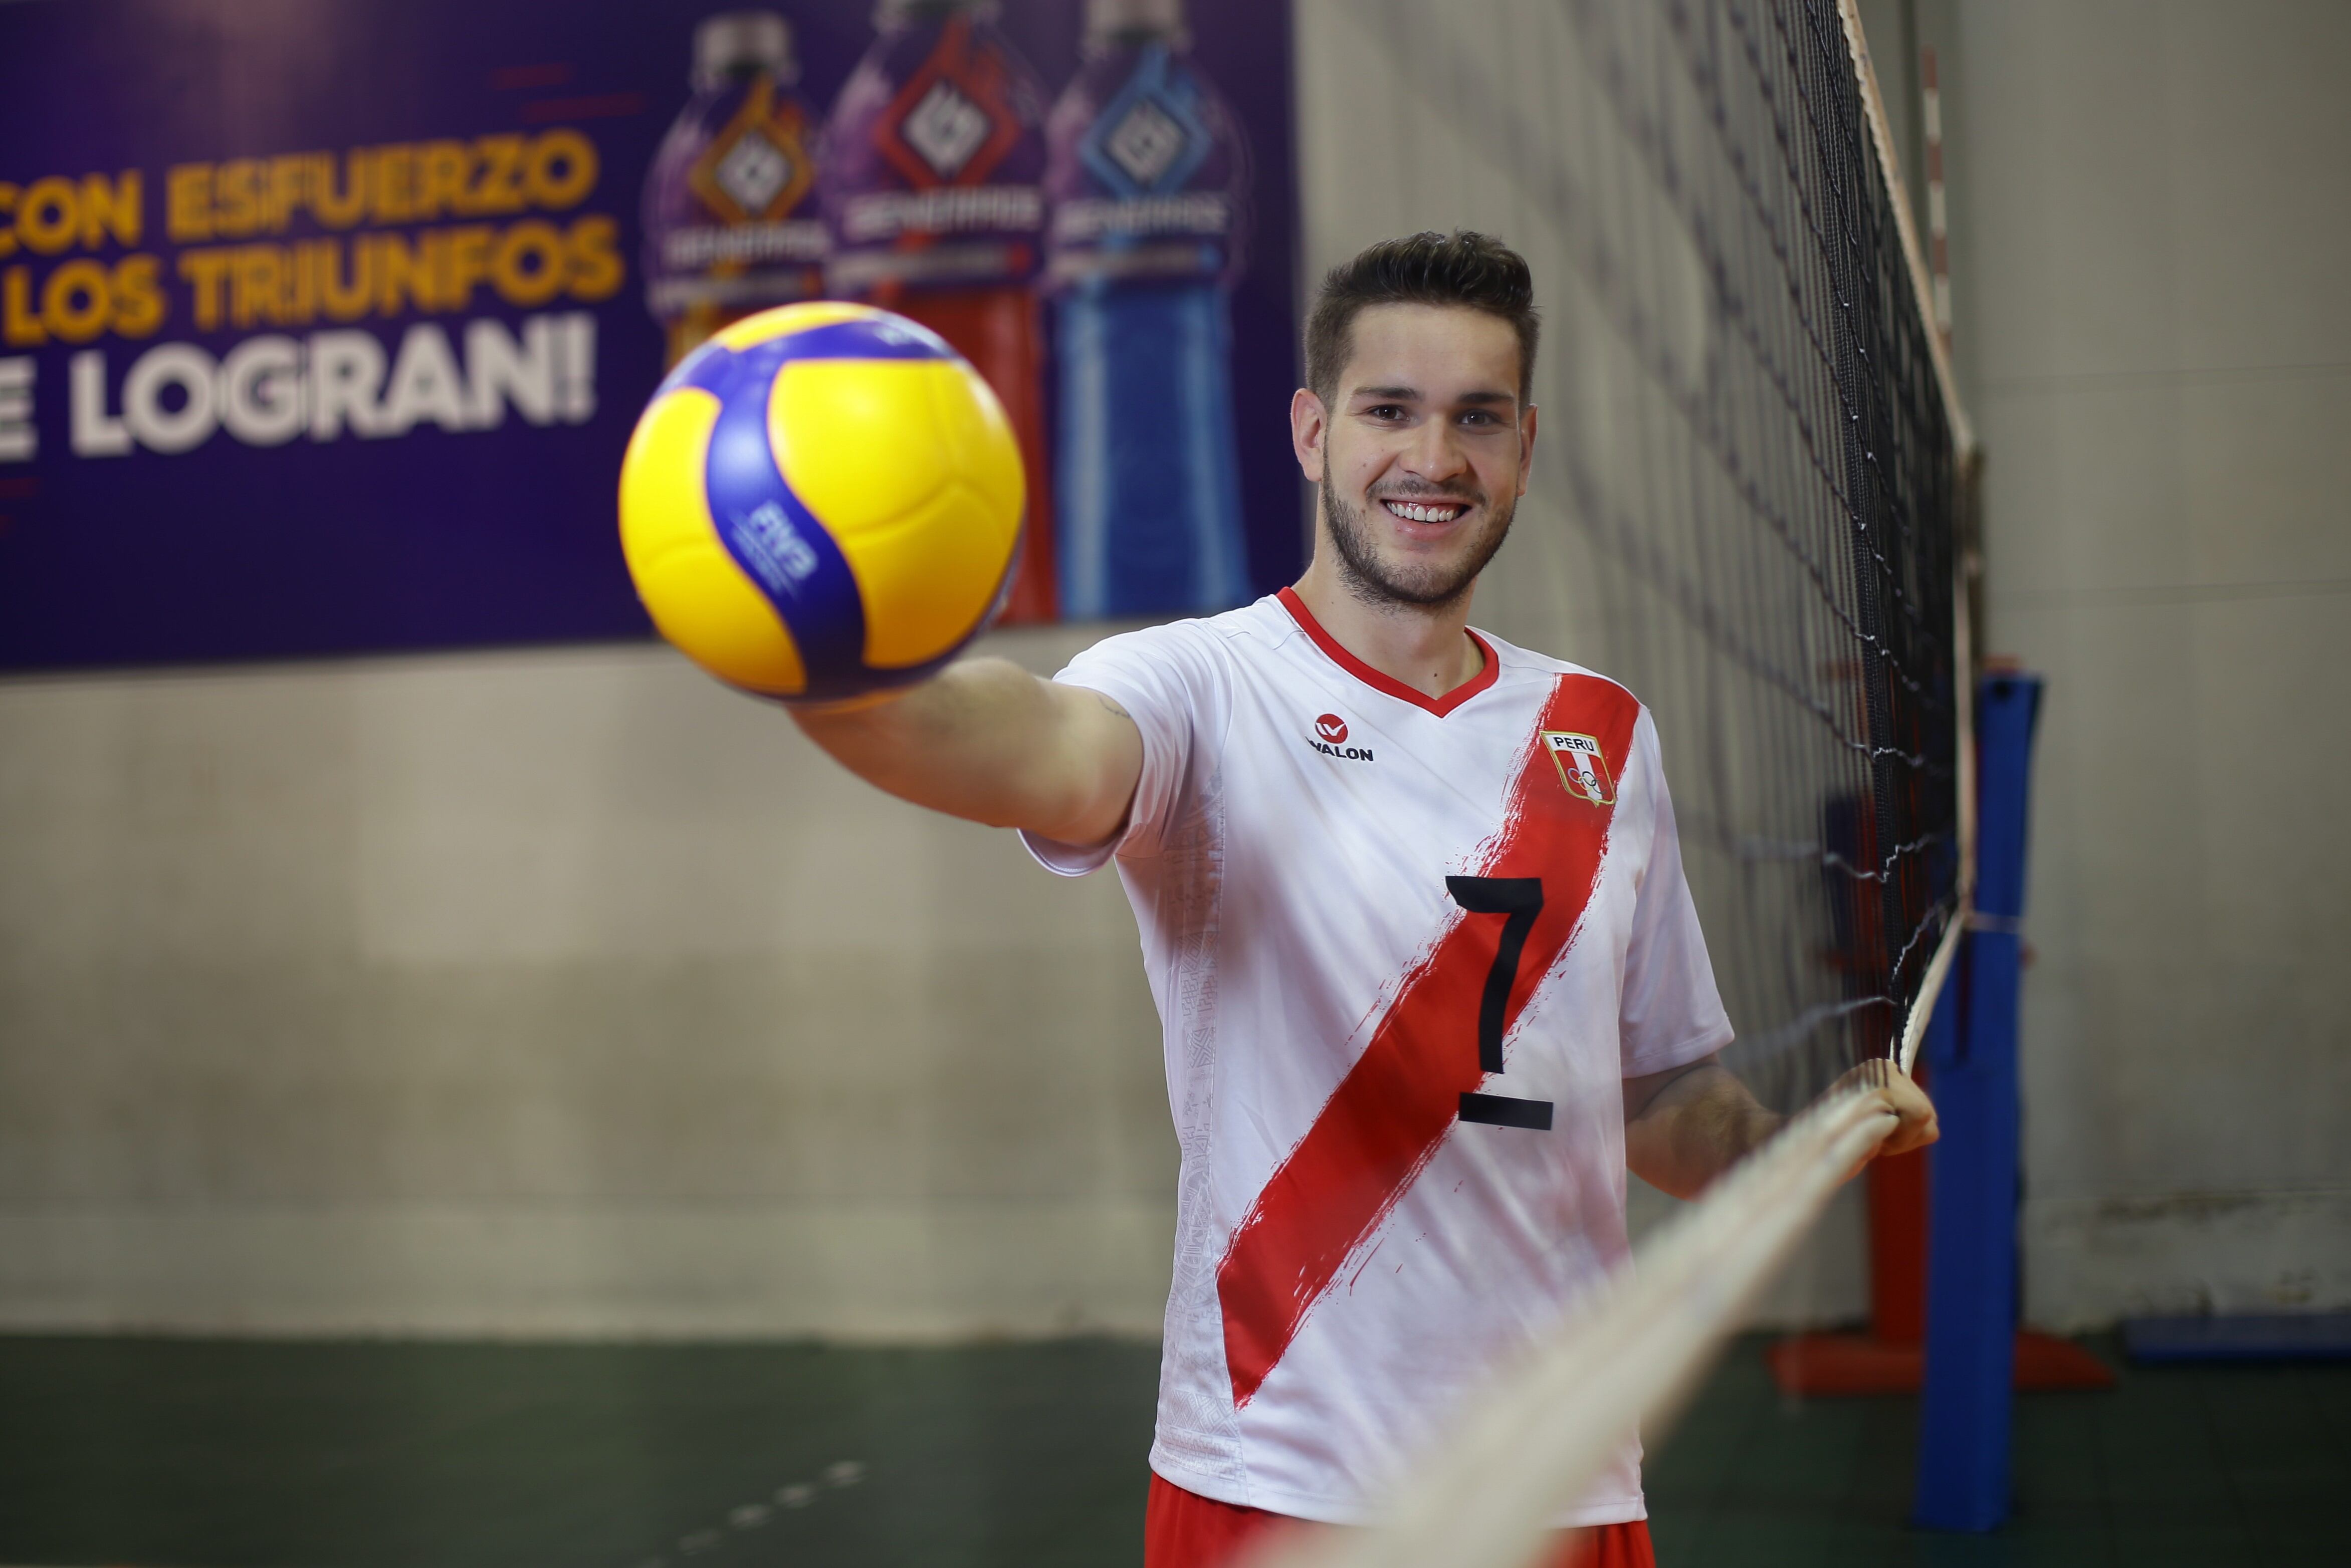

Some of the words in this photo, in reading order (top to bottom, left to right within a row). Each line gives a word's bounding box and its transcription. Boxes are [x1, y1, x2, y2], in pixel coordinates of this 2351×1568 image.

[166, 127, 598, 243] ESFUERZO
[3, 255, 166, 346] LOS
[178, 213, 623, 333] TRIUNFOS
[70, 311, 596, 457] LOGRAN!
[1554, 737, 1594, 752] PERU
[1445, 875, 1543, 1074] 7
